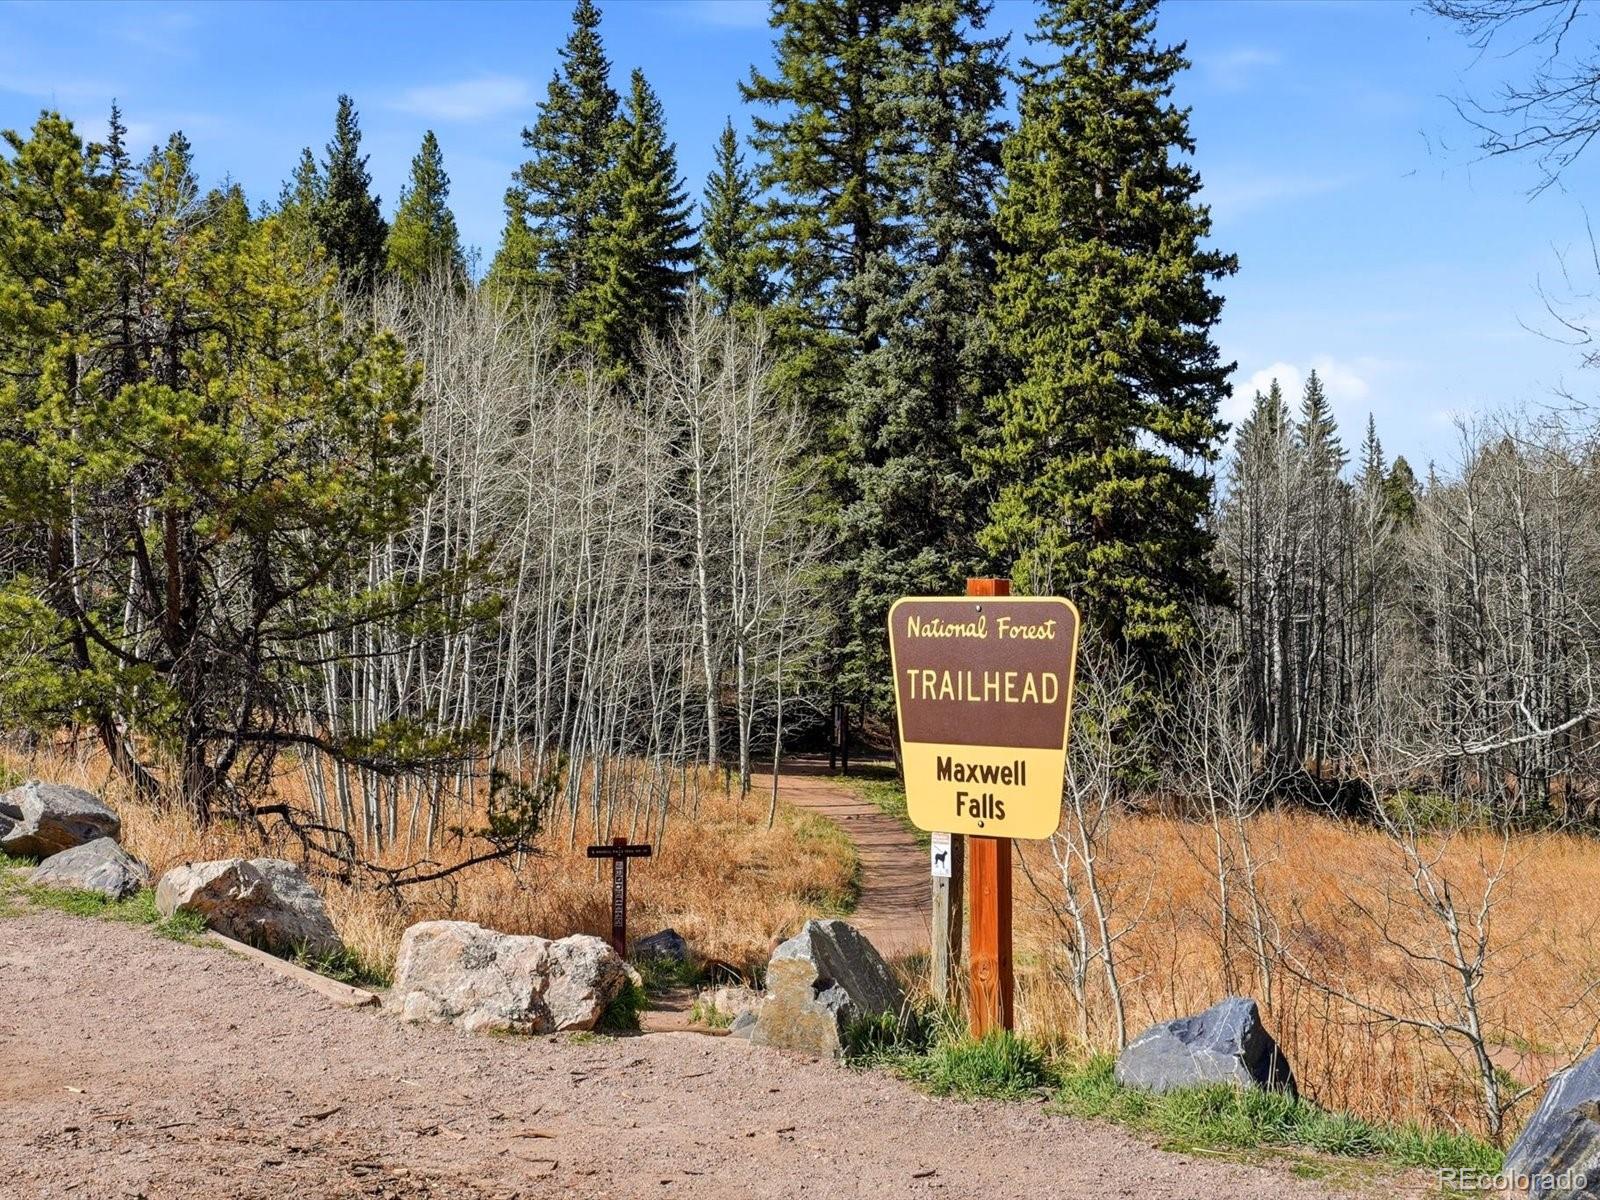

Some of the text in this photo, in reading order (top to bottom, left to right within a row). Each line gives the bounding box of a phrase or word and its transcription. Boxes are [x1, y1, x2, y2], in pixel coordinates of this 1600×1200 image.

[907, 615, 1057, 640] National Forest
[906, 669, 1059, 704] TRAILHEAD
[936, 756, 1026, 786] Maxwell
[956, 791, 1006, 820] Falls
